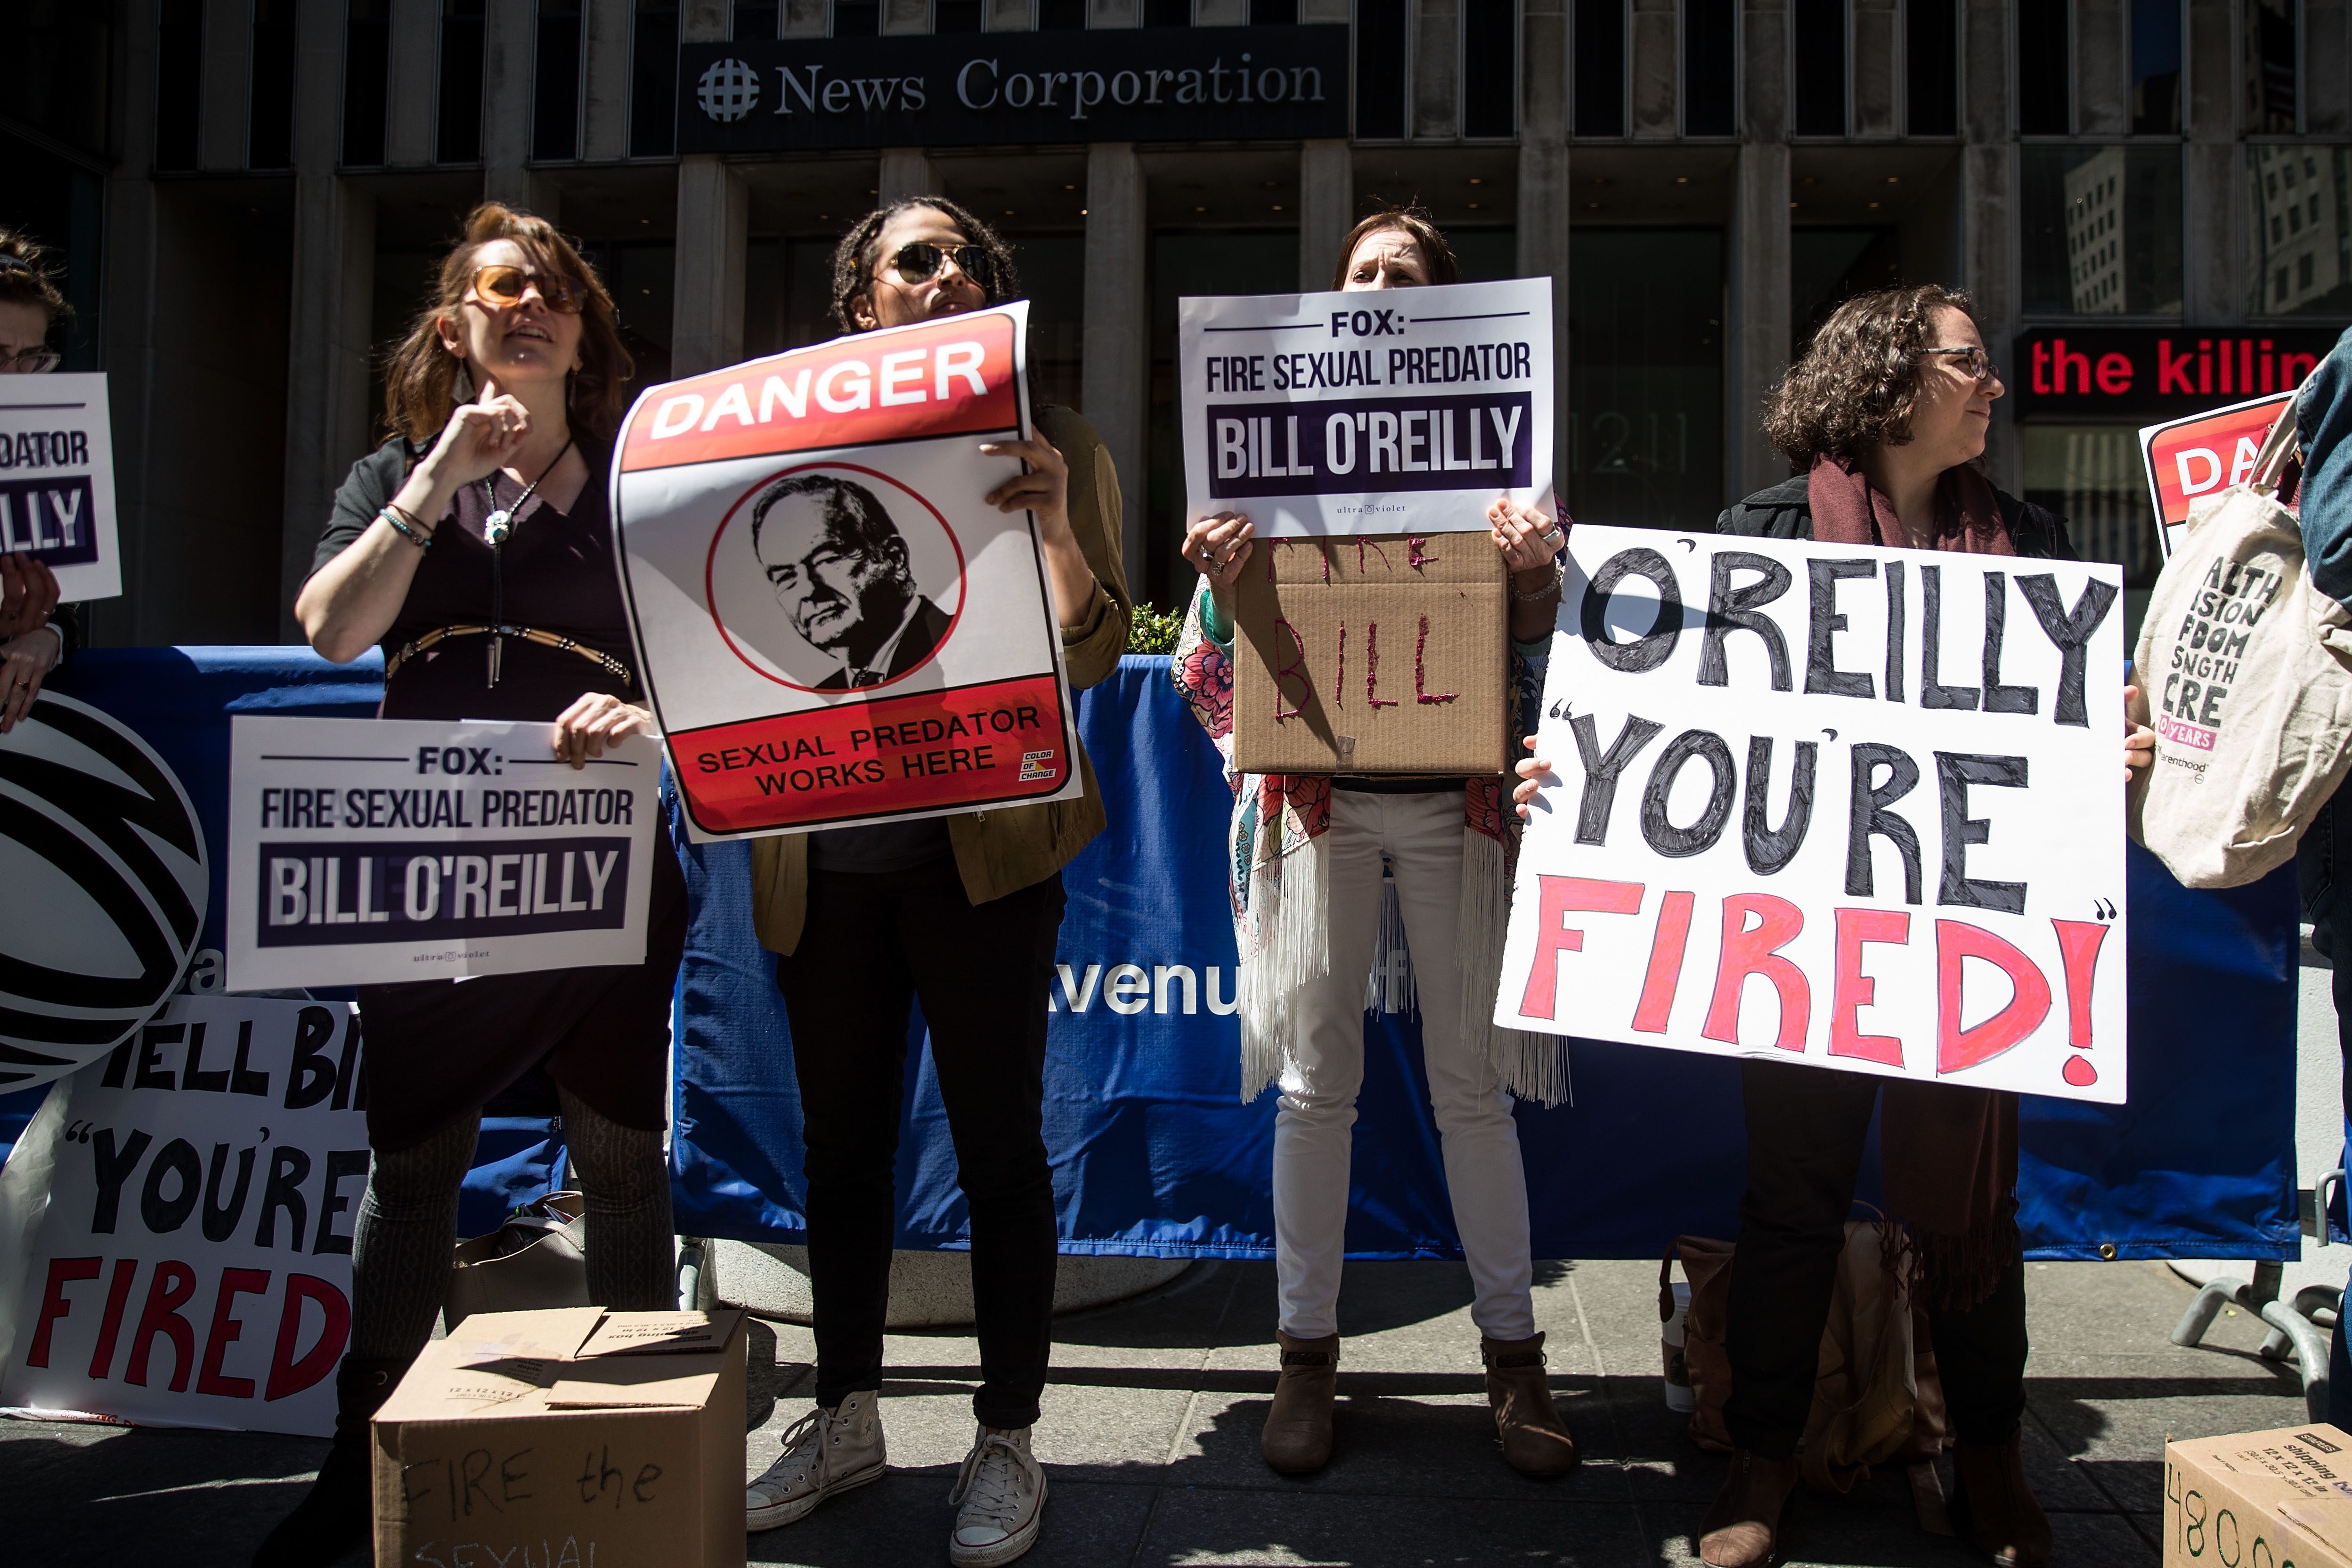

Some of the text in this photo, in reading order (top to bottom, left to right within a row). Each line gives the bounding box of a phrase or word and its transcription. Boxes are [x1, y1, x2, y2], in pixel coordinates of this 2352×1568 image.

[774, 53, 1325, 120] News Corporation
[1332, 309, 1404, 338] FOX:
[651, 340, 988, 439] DANGER
[1207, 342, 1531, 392] FIRE SEXUAL PREDATOR
[2032, 339, 2134, 395] the
[1216, 406, 1522, 479] BILL O'REILLY
[1581, 538, 2120, 728] O'REILLY
[1276, 614, 1460, 720] BILL
[699, 706, 1042, 774] SEXUAL PREDATOR
[1025, 751, 1052, 760] COLOR
[2168, 723, 2210, 747] YEARS
[419, 746, 503, 775] FOX:
[756, 745, 996, 796] WORKS HERE
[1021, 770, 1054, 780] CHANGE
[2161, 754, 2207, 772] arenthood
[262, 788, 634, 828] FIRE SEXUAL PREDATOR
[269, 850, 619, 926] BILL O'REILLY
[414, 954, 443, 962] ultra
[1049, 963, 1241, 1016] venu
[26, 1256, 351, 1402] FIRED
[2262, 1447, 2279, 1455] 12
[2281, 1461, 2299, 1470] 12
[2302, 1476, 2319, 1485] 12
[2283, 1444, 2338, 1479] shipping
[2301, 1434, 2336, 1452] STAPLES
[402, 1445, 663, 1522] FIRE the
[2243, 1450, 2265, 1460] (30.5
[2264, 1463, 2284, 1475] 30.5
[2285, 1479, 2304, 1489] 30.5
